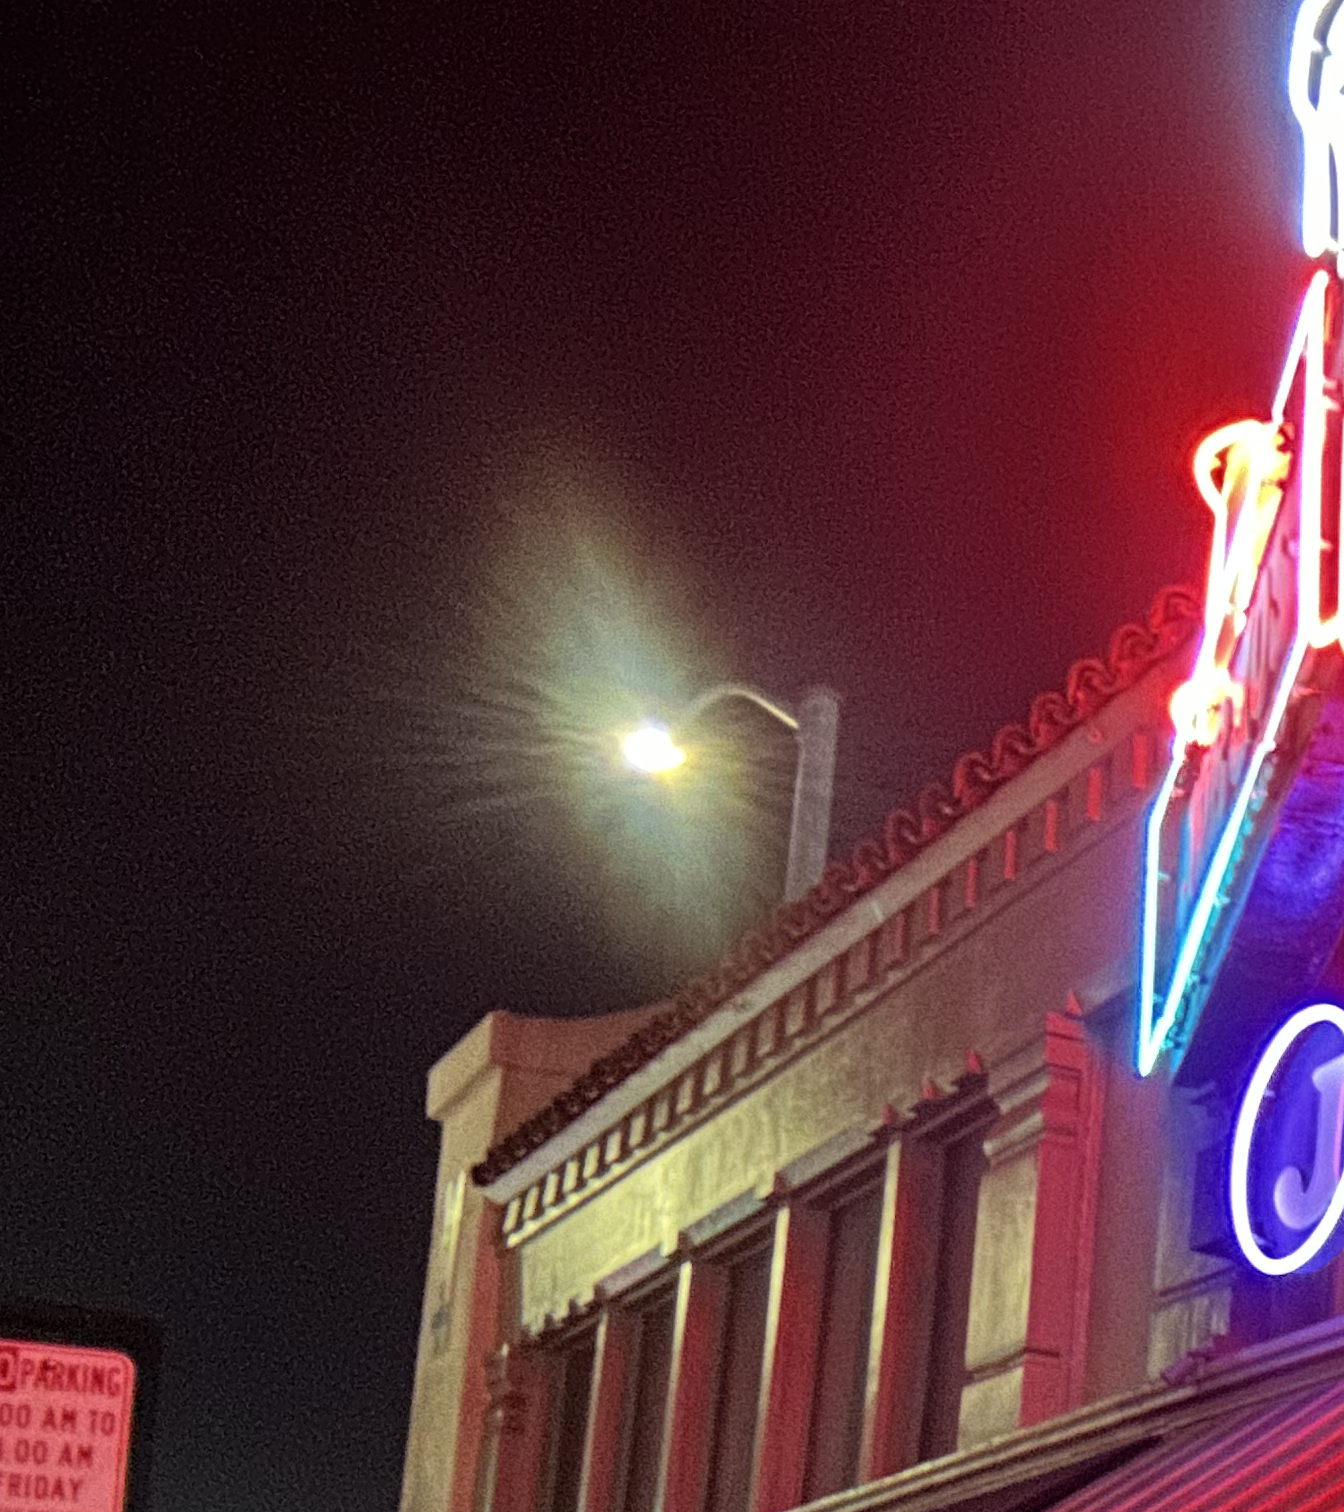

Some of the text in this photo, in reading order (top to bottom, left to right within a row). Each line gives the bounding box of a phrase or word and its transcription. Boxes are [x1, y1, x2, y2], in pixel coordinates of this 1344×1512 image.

[20, 1357, 121, 1397] PARKING
[42, 1405, 77, 1434] AM
[90, 1410, 116, 1437] TO
[57, 1442, 94, 1469] AM
